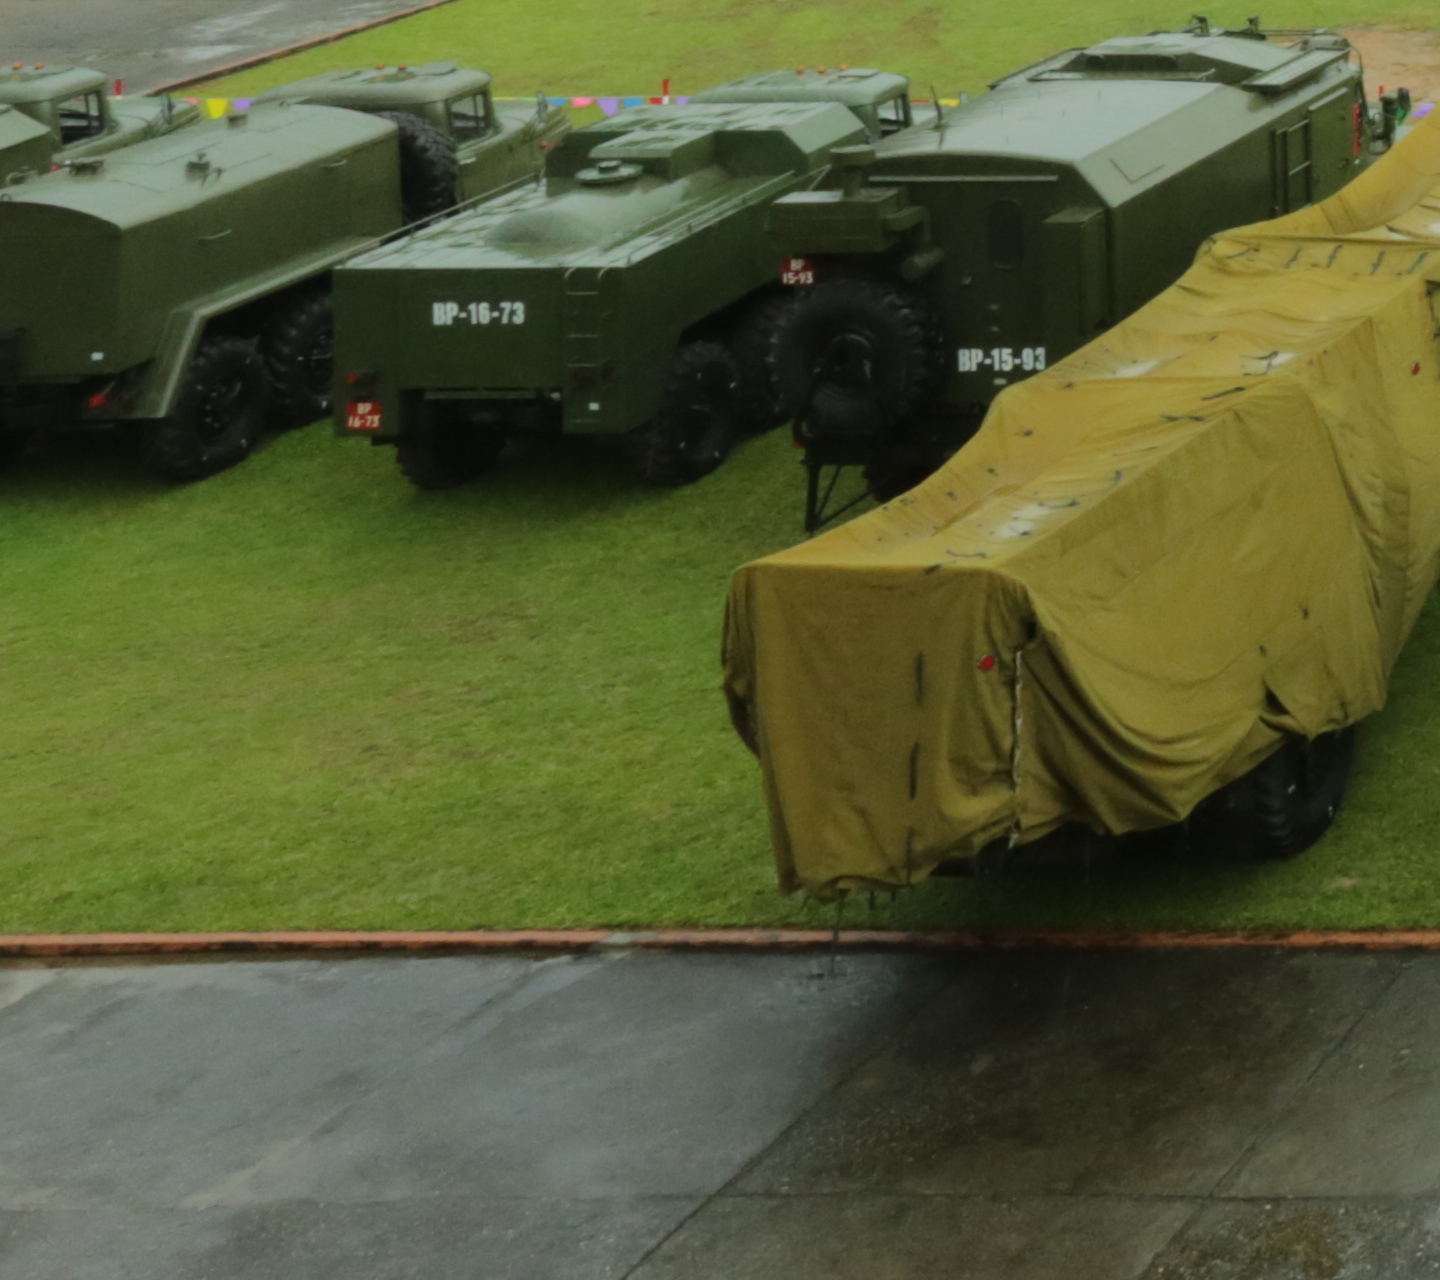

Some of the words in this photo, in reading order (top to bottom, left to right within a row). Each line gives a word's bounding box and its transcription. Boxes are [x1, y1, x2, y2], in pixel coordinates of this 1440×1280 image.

[790, 259, 805, 271] BP
[783, 272, 814, 285] 15-93
[432, 302, 526, 326] BP-16-73
[957, 347, 1046, 372] BP-15-93
[357, 402, 372, 414] BP
[348, 414, 381, 428] 16-73
